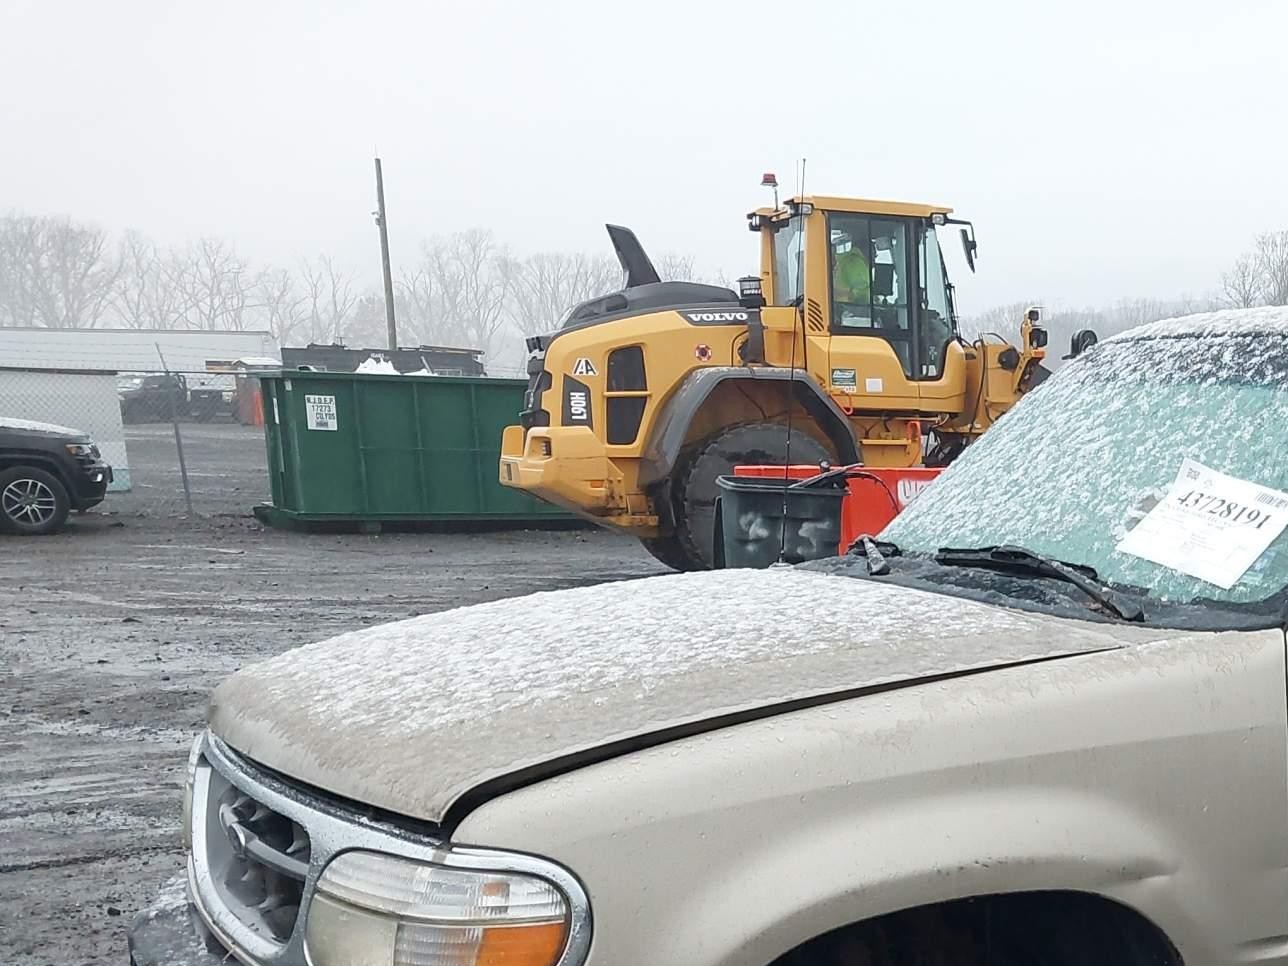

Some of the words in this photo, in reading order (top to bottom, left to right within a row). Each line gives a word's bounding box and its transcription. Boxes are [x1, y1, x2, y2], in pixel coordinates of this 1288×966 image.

[687, 312, 748, 322] VOLVO
[570, 392, 587, 420] L90H
[1177, 490, 1272, 530] 43728191
